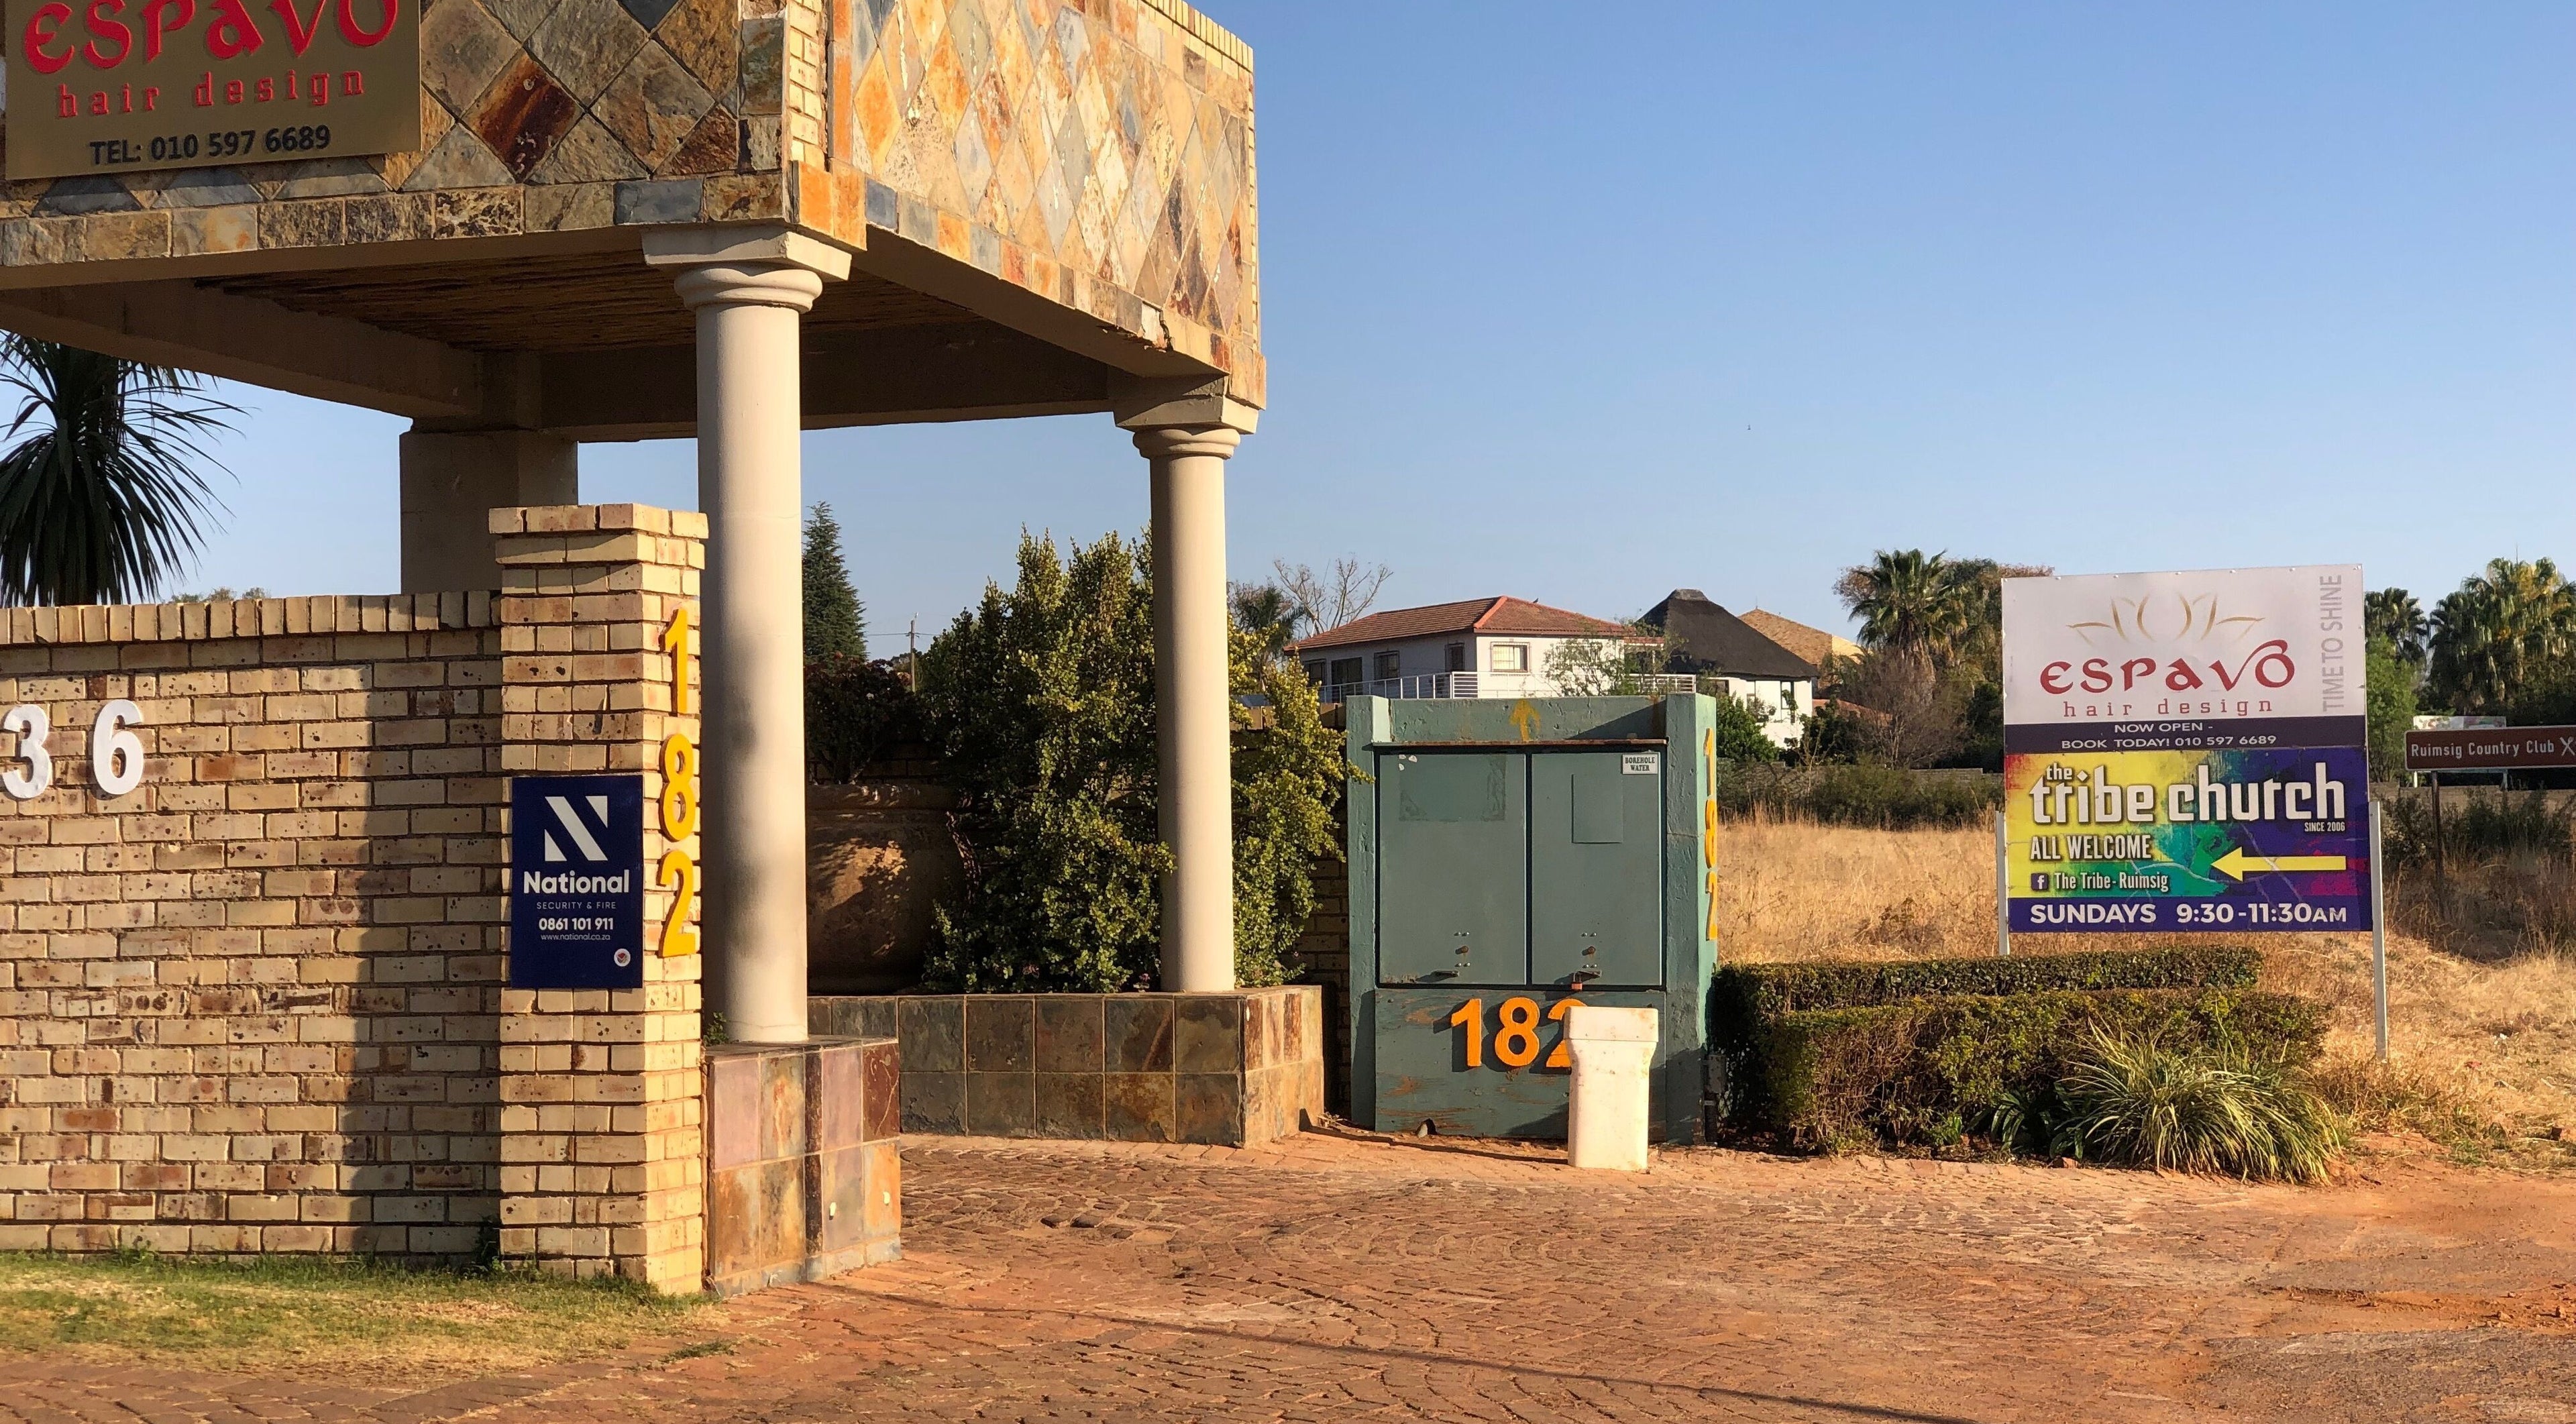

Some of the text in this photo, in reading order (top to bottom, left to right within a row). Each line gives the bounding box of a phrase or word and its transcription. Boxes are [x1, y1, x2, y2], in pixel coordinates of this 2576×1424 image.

[58, 69, 365, 117] hair design
[90, 124, 331, 165] TEL: 010 597 6689
[2320, 575, 2345, 712] TIME TO SHINE
[2063, 698, 2272, 718] hair design
[2114, 724, 2154, 734] NOW
[2158, 722, 2203, 732] OPEN
[2061, 735, 2277, 749] BOOK TODAY! 010 597 6689
[2411, 740, 2555, 759] Ruimsig Country Club
[2046, 763, 2073, 781] the
[2029, 762, 2345, 823] tribe church
[2304, 821, 2345, 832] SINCE 2006
[2031, 834, 2152, 860] ALL WELCOME
[523, 869, 629, 894] National
[2054, 872, 2076, 889] The
[537, 901, 582, 910] SECURITY
[2030, 903, 2157, 924] SUNDAYS
[539, 917, 614, 930] 0861 101 911
[541, 933, 611, 941] www.national.co.za
